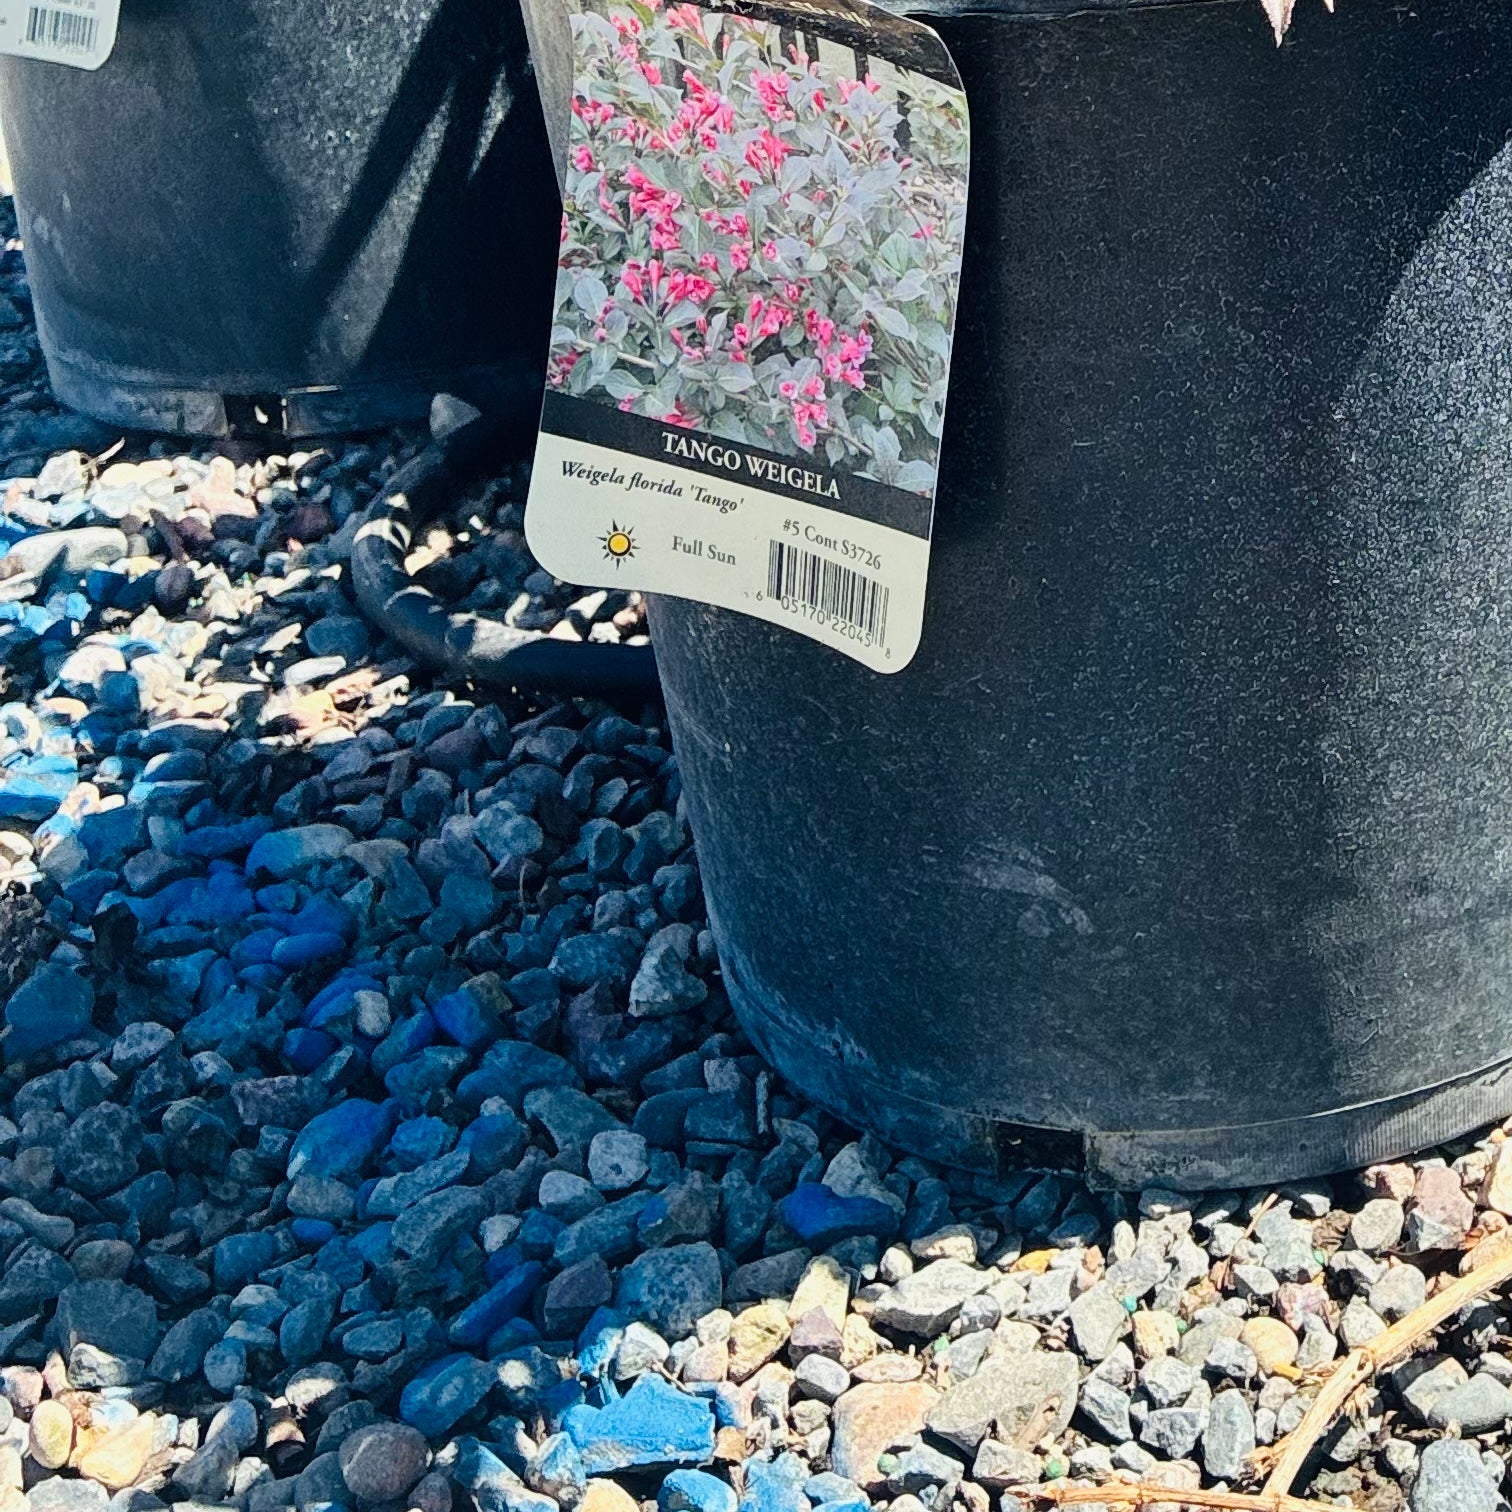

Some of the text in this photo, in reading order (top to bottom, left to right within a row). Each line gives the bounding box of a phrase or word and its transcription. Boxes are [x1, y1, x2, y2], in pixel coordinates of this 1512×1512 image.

[561, 460, 744, 513] Weigela florida 'Tango'
[661, 431, 841, 500] TANGO WEIGELA
[671, 535, 737, 566] Full Sun
[782, 518, 882, 570] #5 Cont S3726
